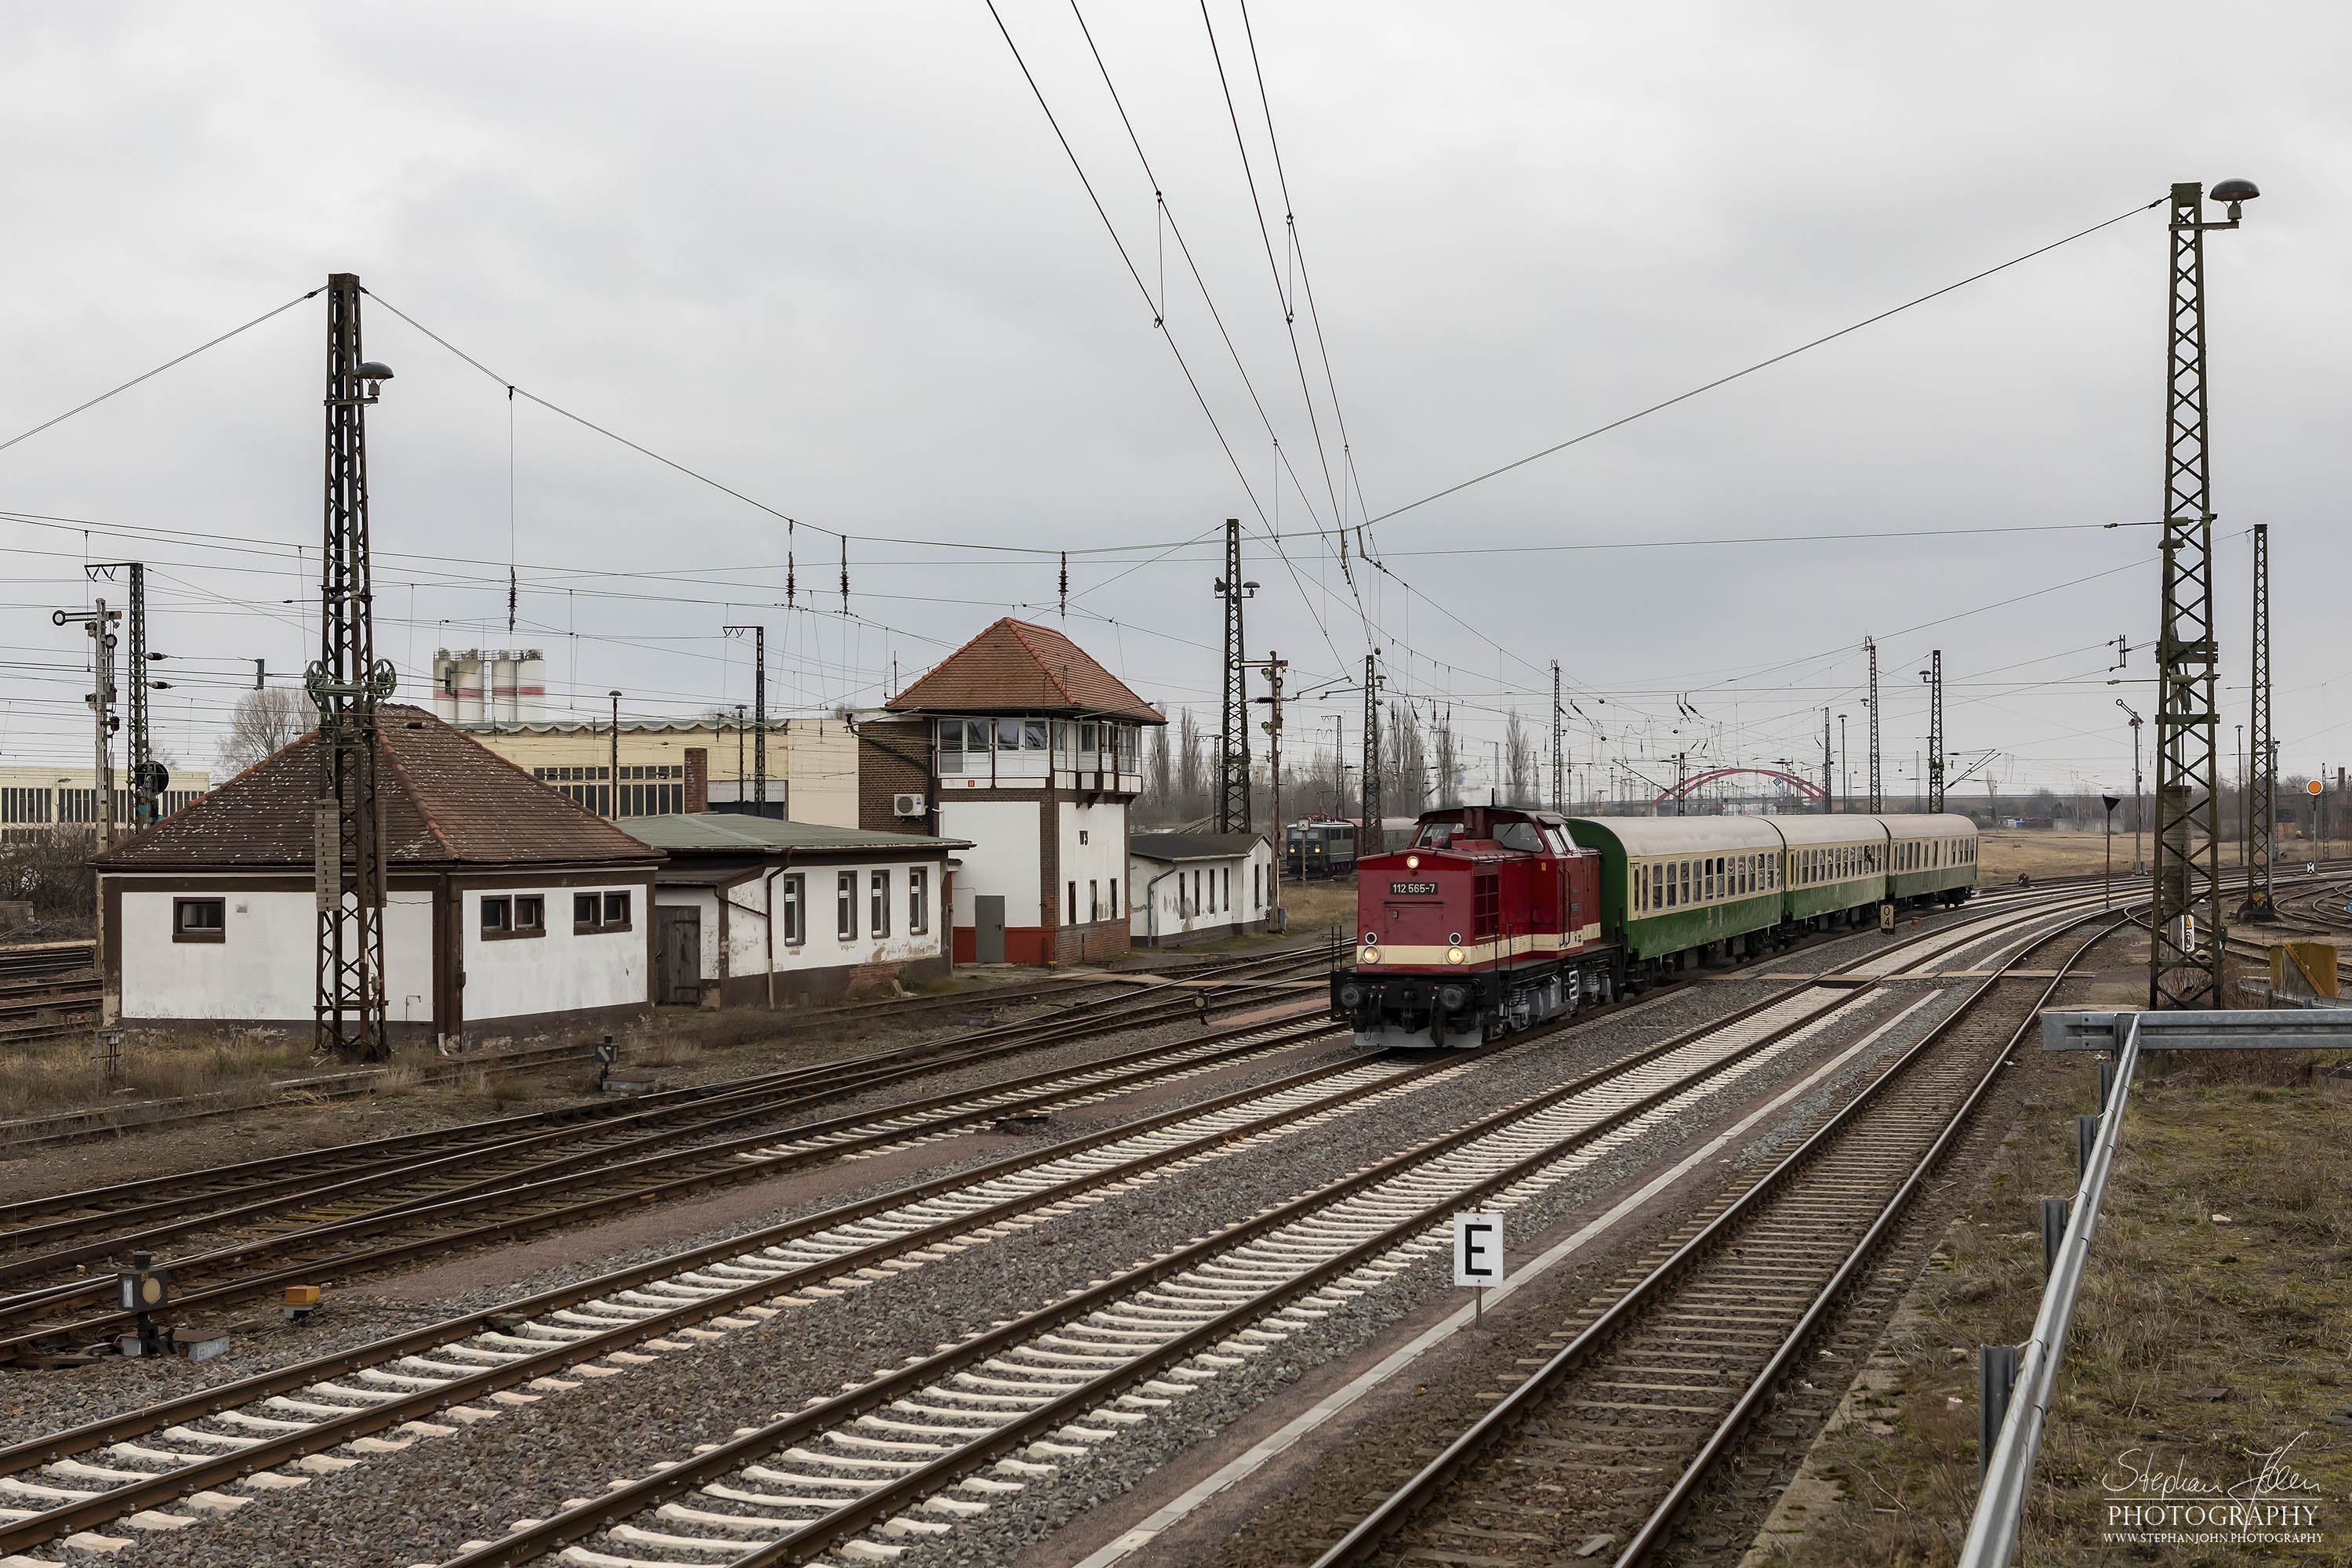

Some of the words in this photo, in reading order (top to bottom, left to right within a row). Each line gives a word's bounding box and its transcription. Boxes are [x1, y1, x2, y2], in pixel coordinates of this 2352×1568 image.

[1392, 884, 1406, 893] 112
[1408, 884, 1436, 893] 565-7
[1883, 906, 1890, 916] 0
[1884, 916, 1890, 926] 4
[1465, 1224, 1493, 1276] E
